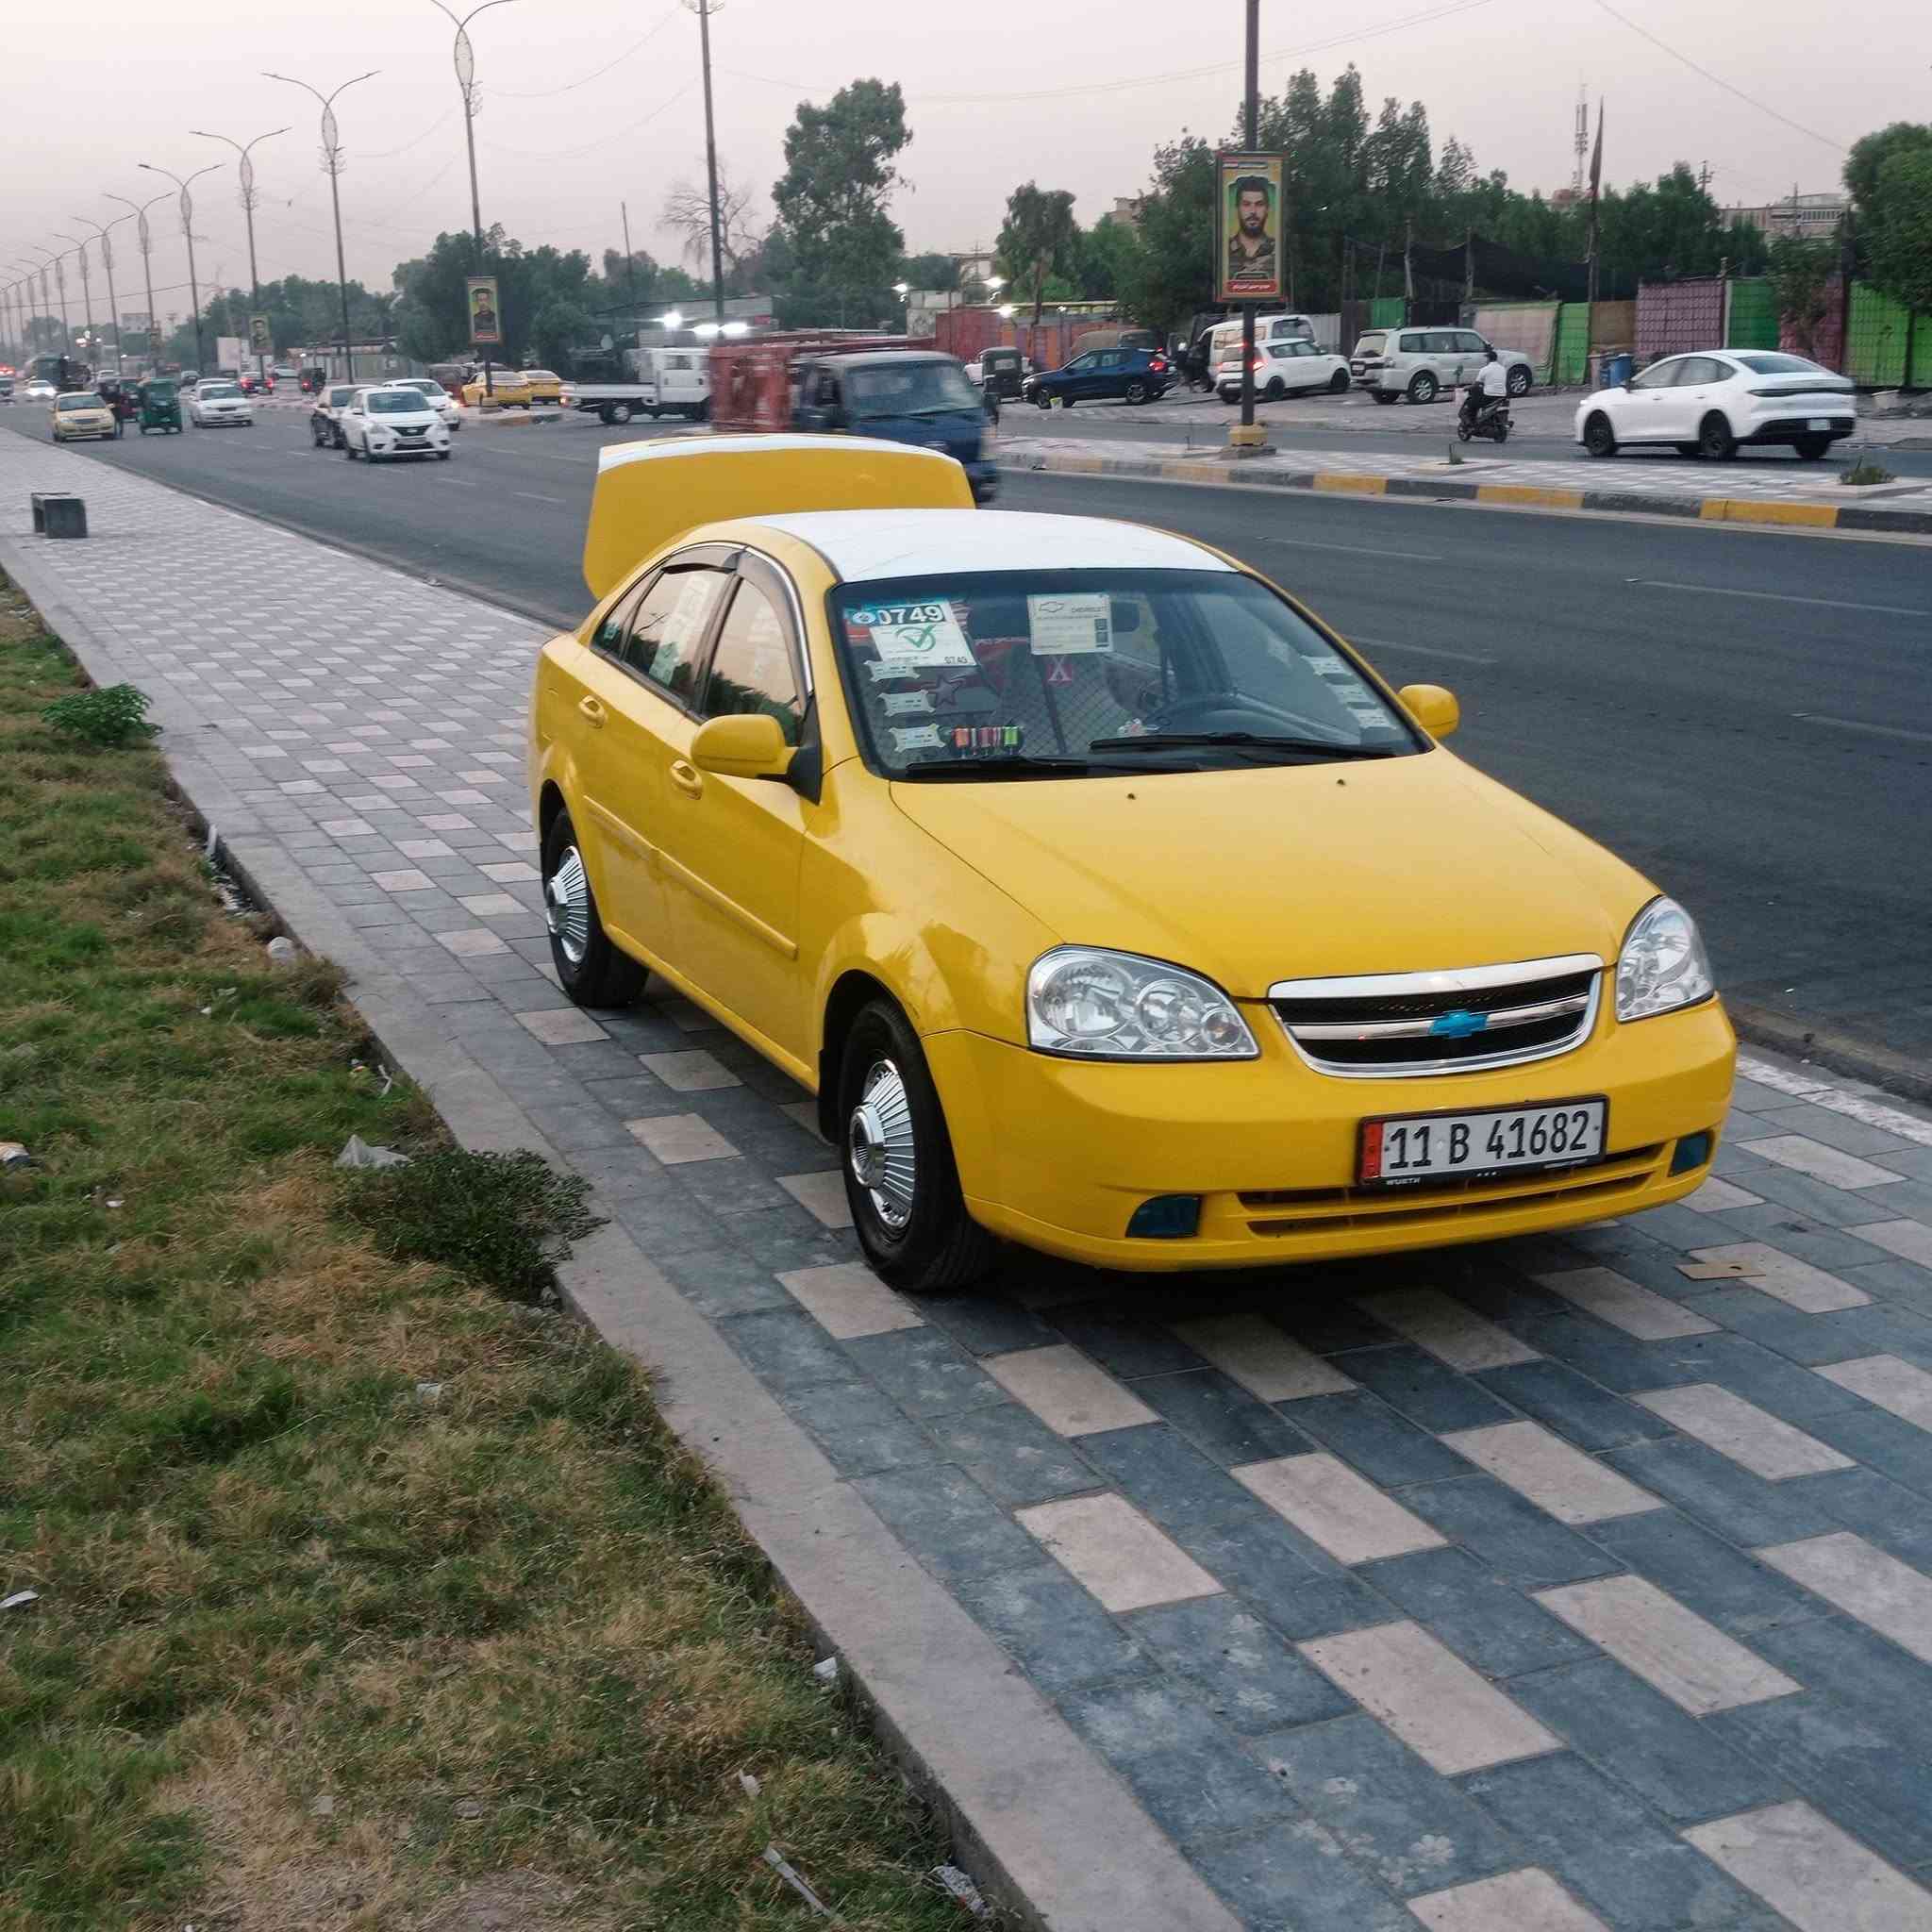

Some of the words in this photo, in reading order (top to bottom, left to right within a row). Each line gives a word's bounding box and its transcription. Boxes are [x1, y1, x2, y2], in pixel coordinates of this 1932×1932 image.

[875, 606, 944, 625] 0749
[1389, 1125, 1432, 1170] 11
[1449, 1123, 1471, 1165] B
[1486, 1110, 1590, 1159] 41682
